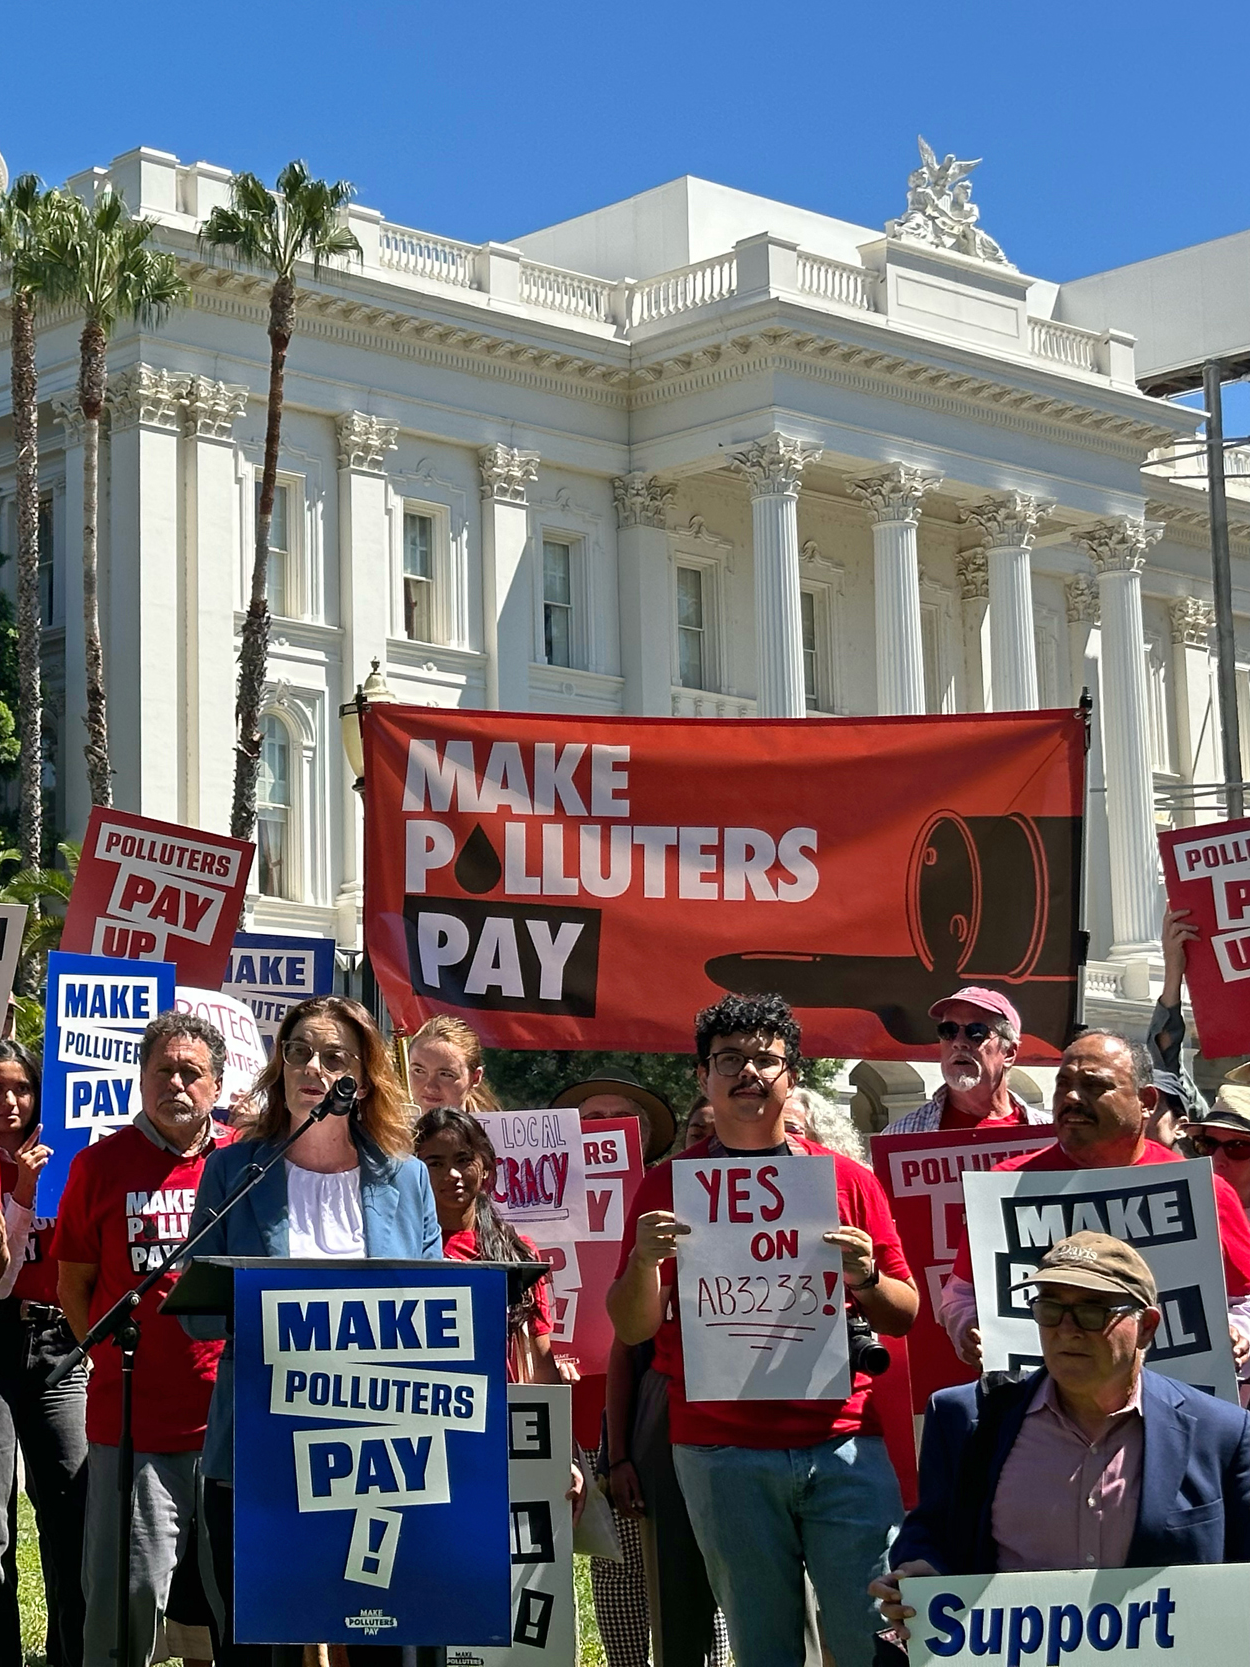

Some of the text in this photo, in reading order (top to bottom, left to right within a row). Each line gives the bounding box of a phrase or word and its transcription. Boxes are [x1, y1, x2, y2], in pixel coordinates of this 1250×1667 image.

[402, 739, 630, 817] MAKE
[105, 832, 231, 877] POLLUTERS
[119, 874, 214, 932] PAY
[102, 926, 156, 959] UP
[417, 911, 584, 1000] PAY
[65, 984, 150, 1019] MAKE
[65, 1031, 141, 1065] POLLUTER
[72, 1078, 133, 1118] PAY
[501, 1115, 566, 1148] LOCAL
[126, 1189, 195, 1216] MAKE
[695, 1165, 784, 1223] YES
[1014, 1191, 1183, 1247] MAKE
[750, 1230, 798, 1262] ON
[1058, 1244, 1098, 1260] Davis
[278, 1299, 459, 1352] MAKE
[285, 1370, 474, 1418] POLLUTERS
[308, 1435, 432, 1497] PAY
[362, 1518, 388, 1574] !
[349, 1618, 395, 1626] POLLUTERS
[924, 1587, 1175, 1667] Support
